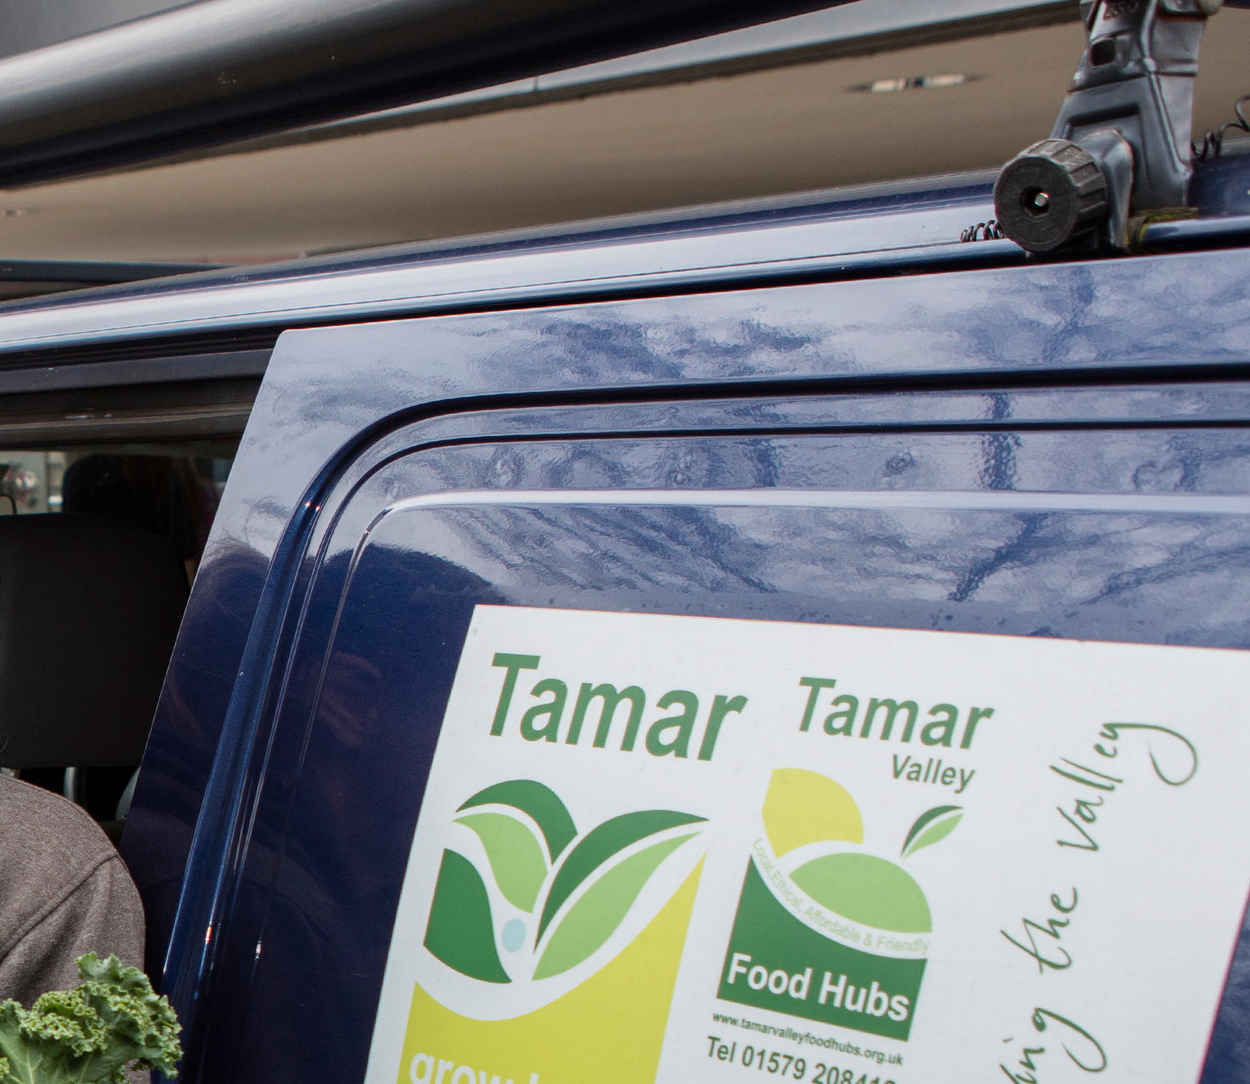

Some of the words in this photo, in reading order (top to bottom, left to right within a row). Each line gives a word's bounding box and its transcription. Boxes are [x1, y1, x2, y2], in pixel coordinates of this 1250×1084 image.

[489, 652, 748, 761] Tamar
[798, 676, 995, 749] Tamar
[891, 754, 976, 793] Valley
[804, 905, 860, 942] Affordable
[863, 933, 873, 947] &
[877, 936, 930, 955] Friendly
[999, 886, 1078, 974] the
[727, 952, 813, 1000] Food
[818, 971, 910, 1022] Hubs
[707, 1036, 737, 1063] Tel
[742, 1045, 807, 1080] 01579
[712, 1012, 904, 1066] www.tamarvalleyfoodhubs.org.uk
